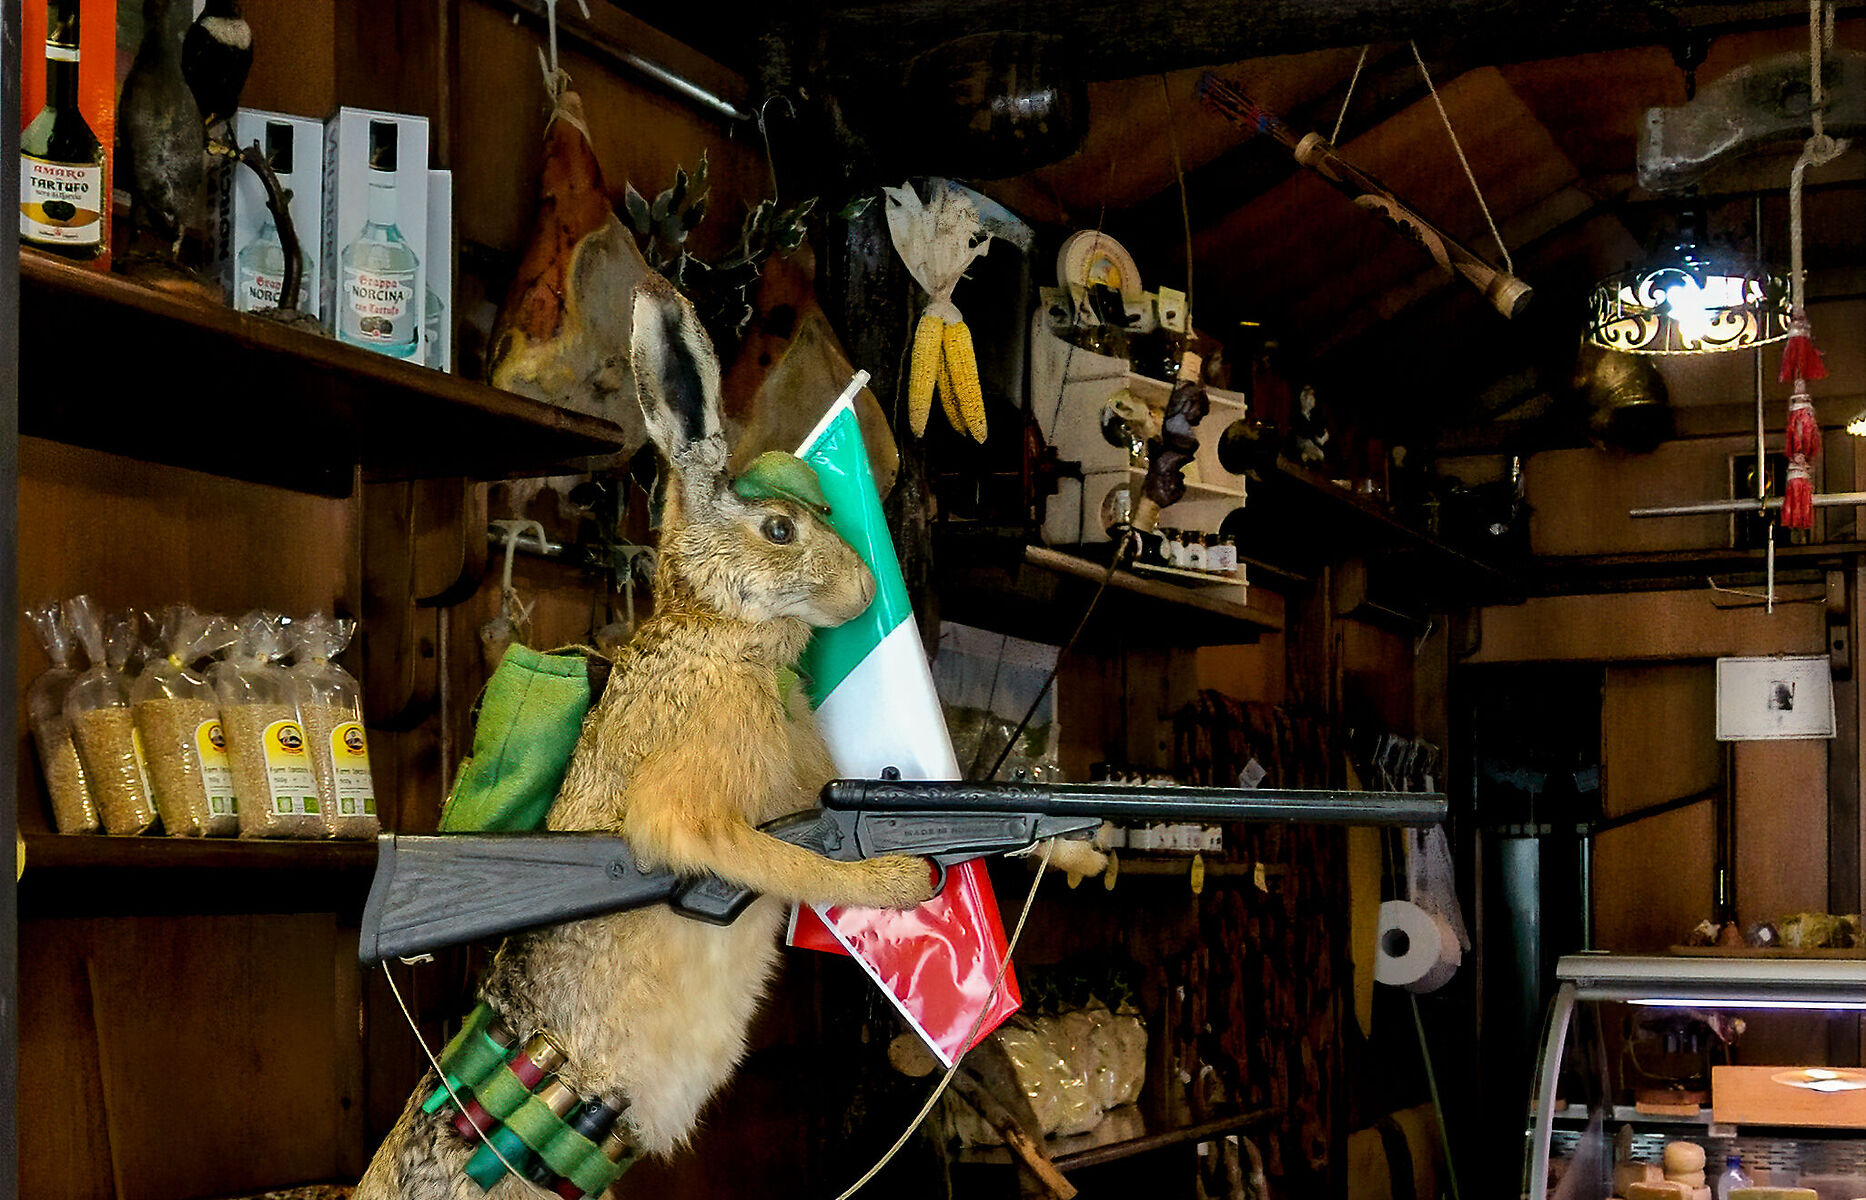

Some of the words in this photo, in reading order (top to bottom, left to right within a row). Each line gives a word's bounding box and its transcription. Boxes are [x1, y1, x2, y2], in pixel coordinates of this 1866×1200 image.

[34, 165, 85, 179] AMARO
[30, 176, 89, 192] TARTUFO
[256, 276, 281, 290] Grap
[249, 286, 280, 303] NORC
[352, 286, 404, 304] NORCINA
